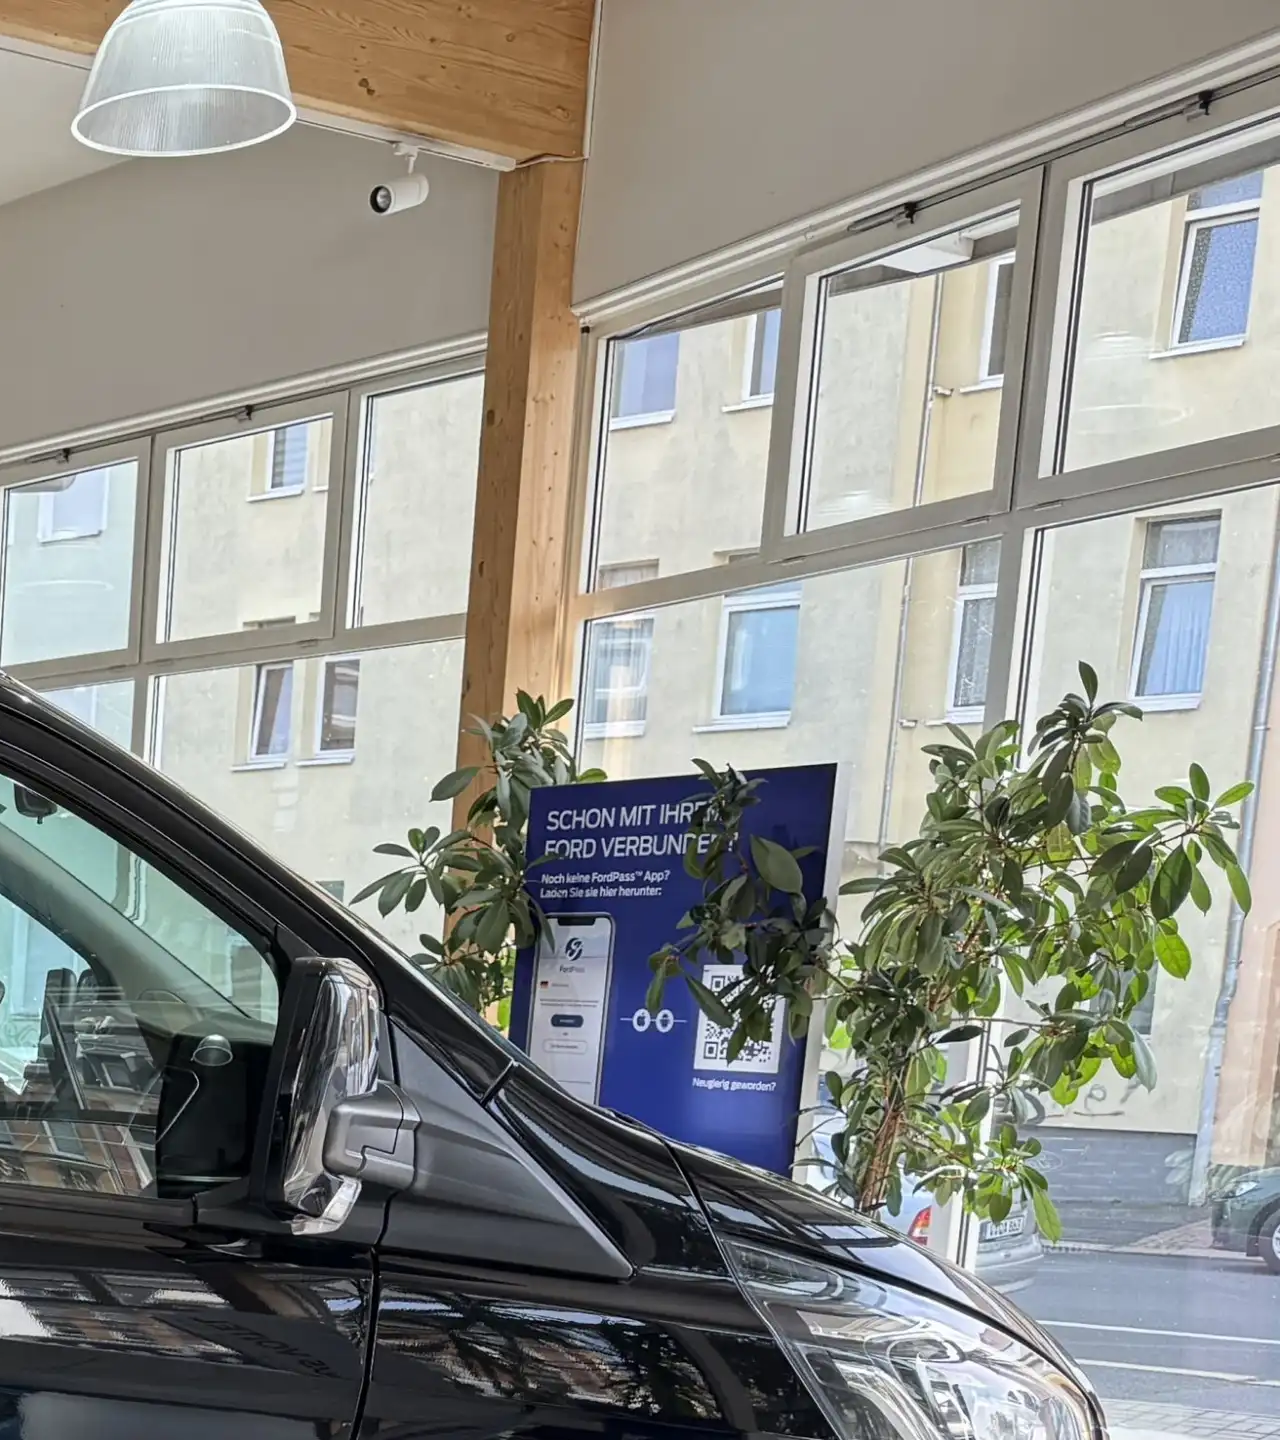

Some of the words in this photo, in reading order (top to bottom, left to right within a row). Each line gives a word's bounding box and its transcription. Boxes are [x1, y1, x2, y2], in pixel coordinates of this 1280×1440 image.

[546, 806, 616, 832] SCHON
[619, 804, 657, 828] MIT
[544, 838, 597, 860] FORD
[540, 873, 565, 885] Noch
[566, 872, 590, 884] keine
[643, 869, 671, 884] App?
[569, 887, 584, 898] Sie
[585, 886, 598, 898] sie
[599, 885, 618, 897] hier
[618, 885, 662, 897] herunter:
